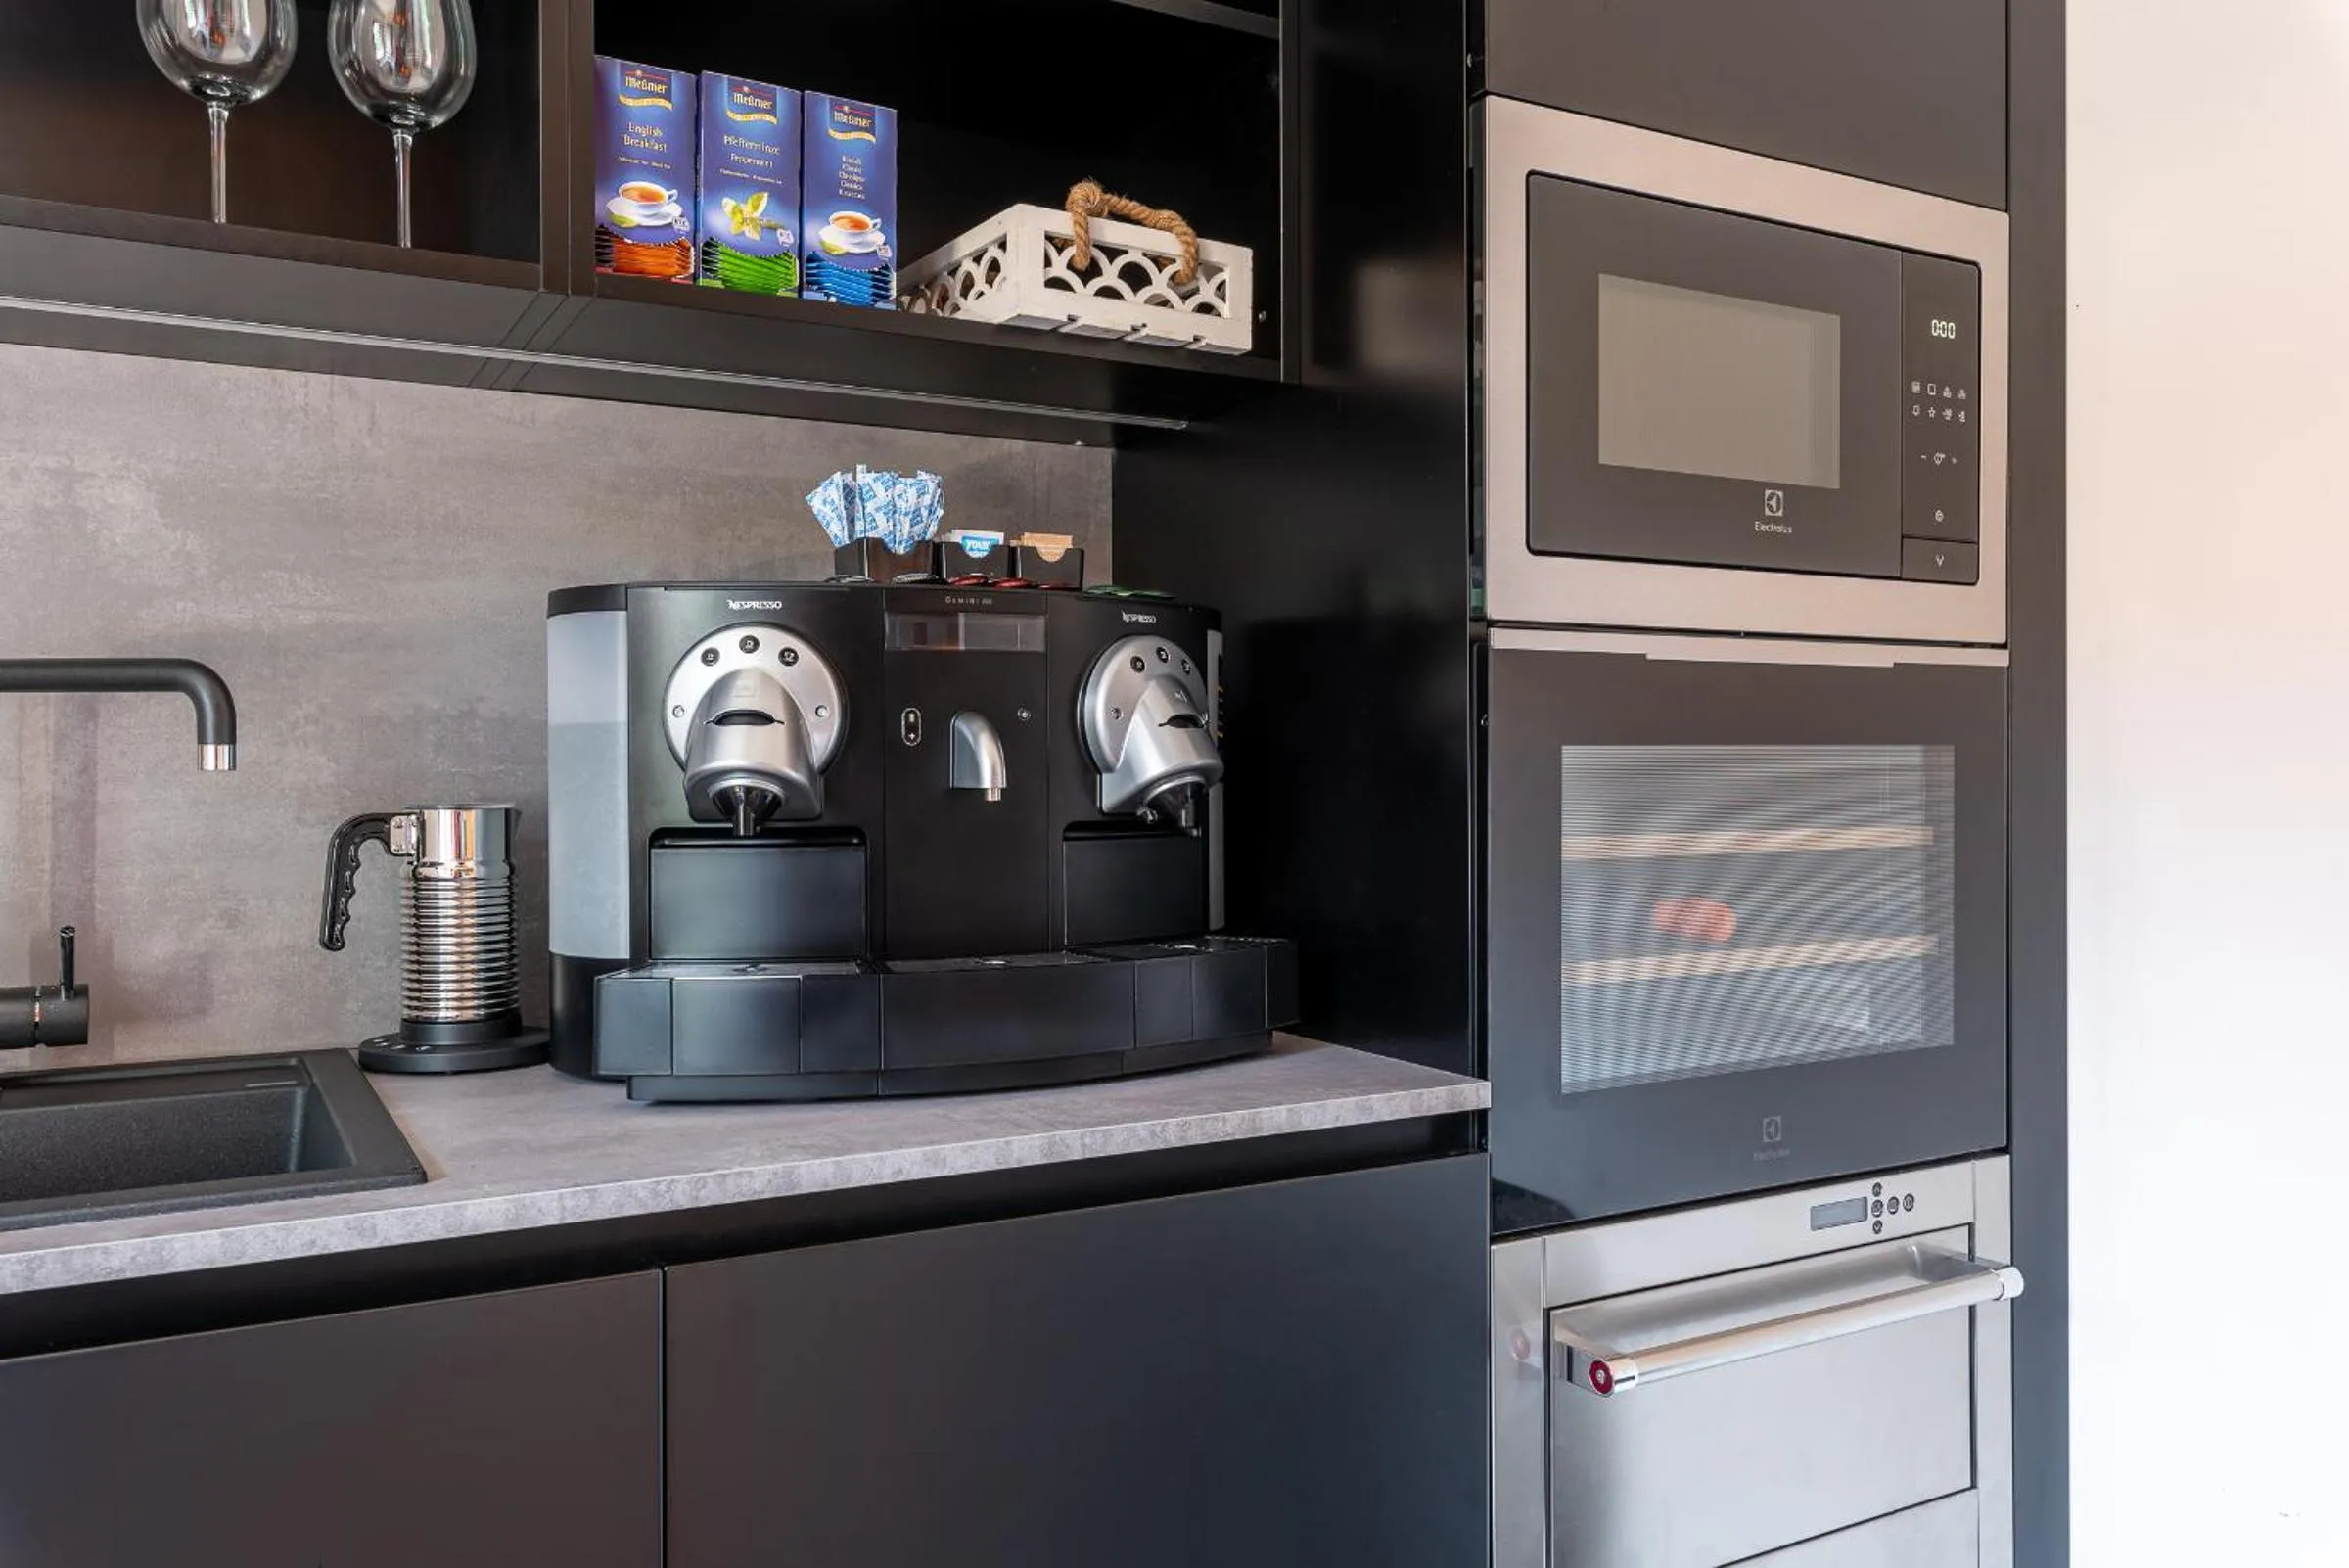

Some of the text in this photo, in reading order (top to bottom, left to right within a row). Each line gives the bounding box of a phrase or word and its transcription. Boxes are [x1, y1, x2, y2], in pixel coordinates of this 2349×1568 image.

[628, 122, 663, 137] English
[623, 134, 668, 152] Breakfast
[726, 599, 782, 610] NESPRESSO
[1121, 610, 1157, 623] NESPRESSO
